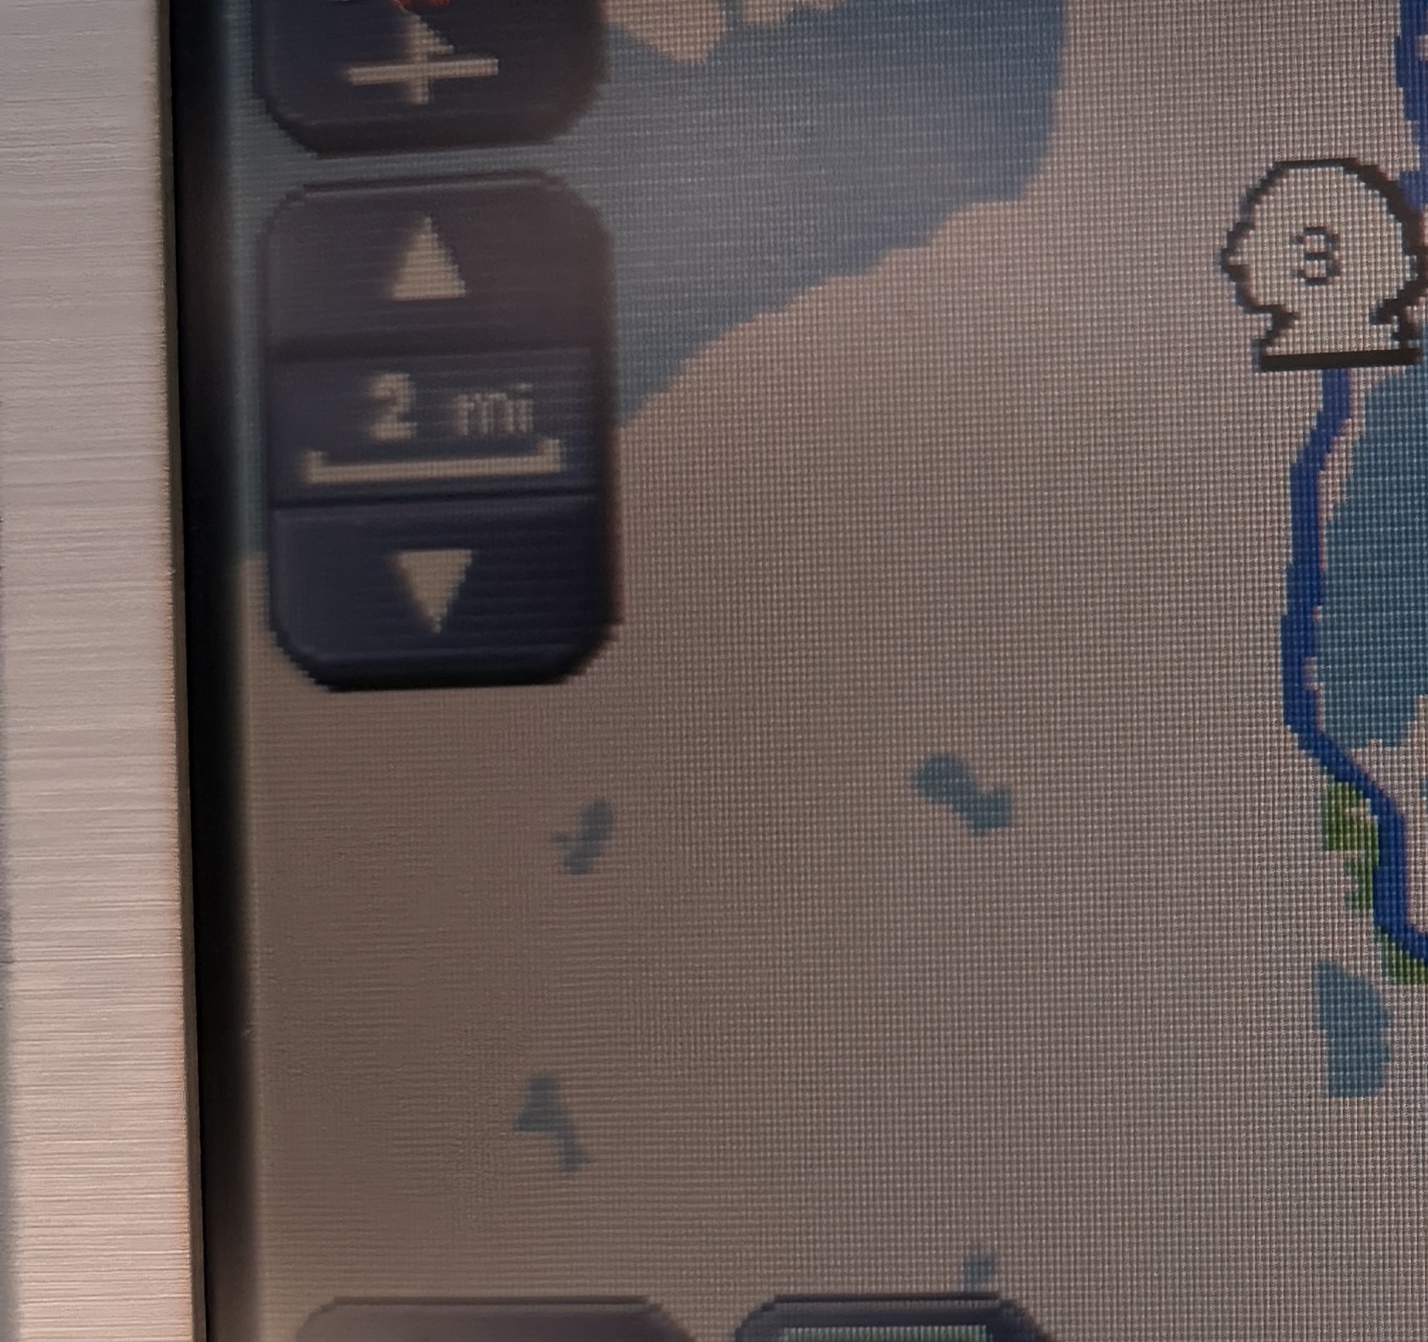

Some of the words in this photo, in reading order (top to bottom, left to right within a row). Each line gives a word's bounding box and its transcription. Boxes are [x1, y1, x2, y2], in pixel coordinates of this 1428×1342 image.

[1294, 224, 1341, 287] 3
[367, 372, 417, 441] 2
[452, 382, 534, 436] mi
